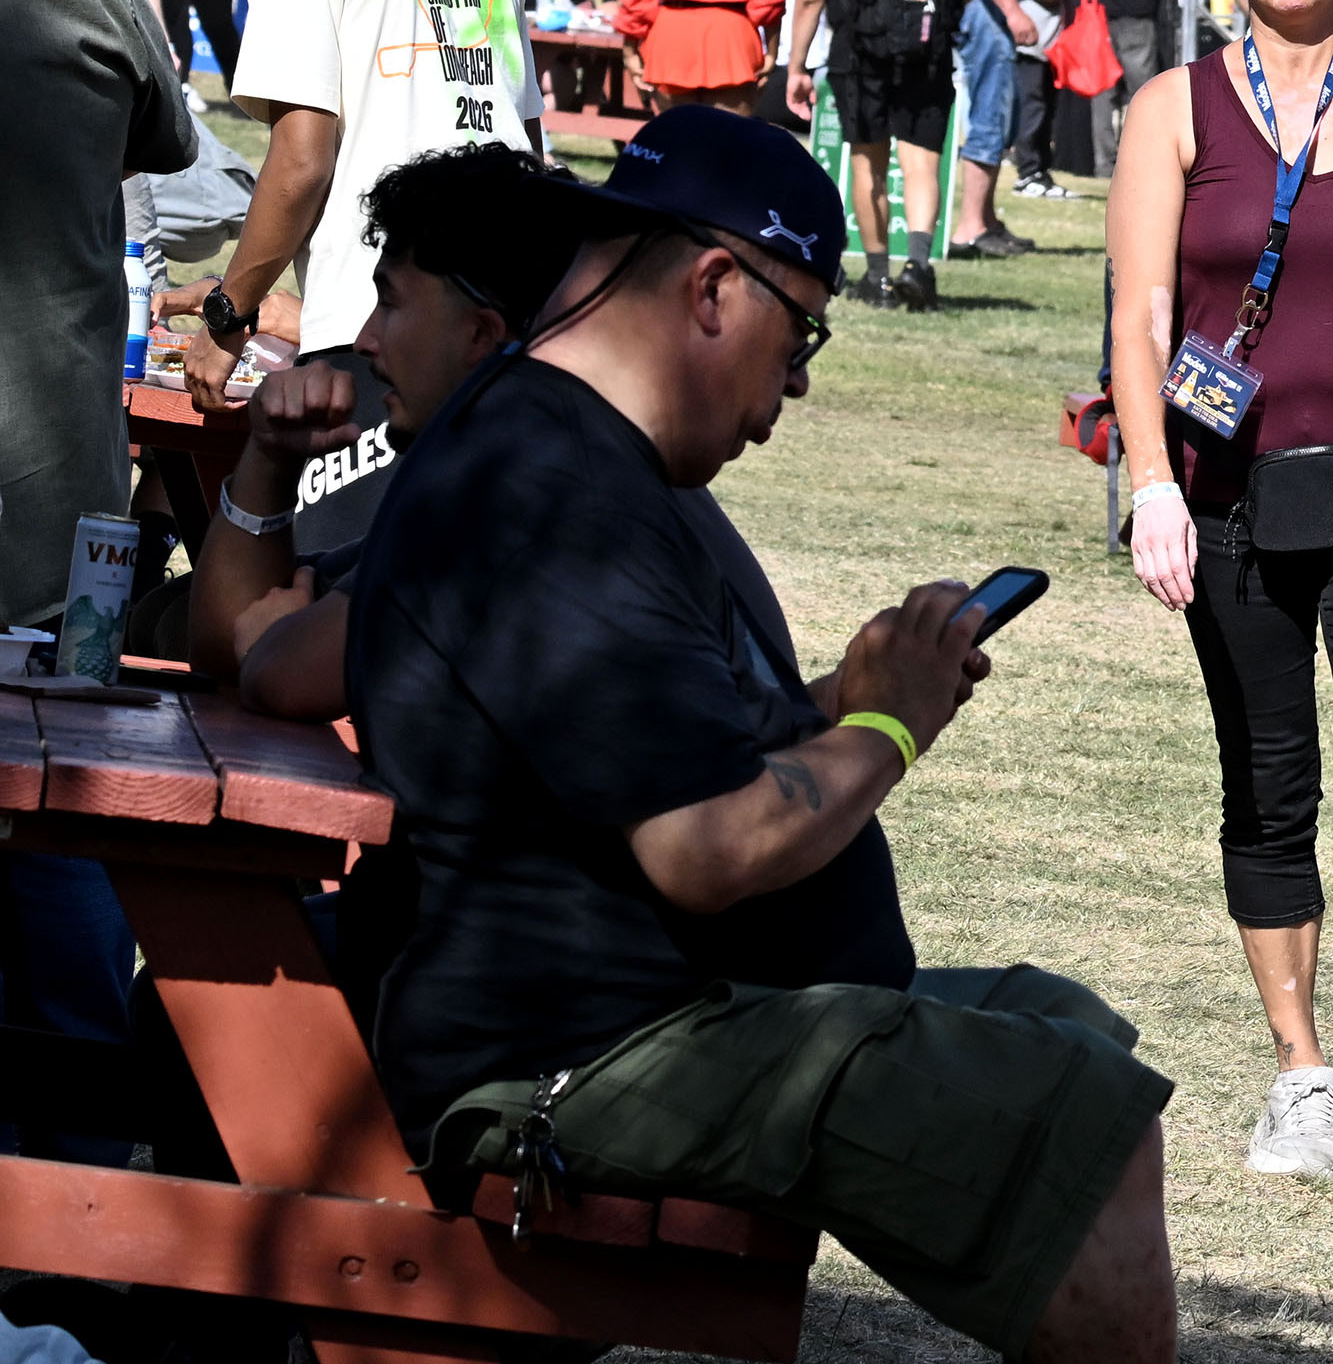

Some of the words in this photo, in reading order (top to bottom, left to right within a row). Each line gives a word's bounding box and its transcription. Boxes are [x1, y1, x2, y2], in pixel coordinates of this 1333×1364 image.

[430, 6, 447, 43] OF
[438, 45, 461, 82] LON
[456, 96, 493, 133] 2026
[129, 286, 151, 297] AFINA
[1181, 351, 1208, 374] Modelo
[295, 420, 396, 513] GELES
